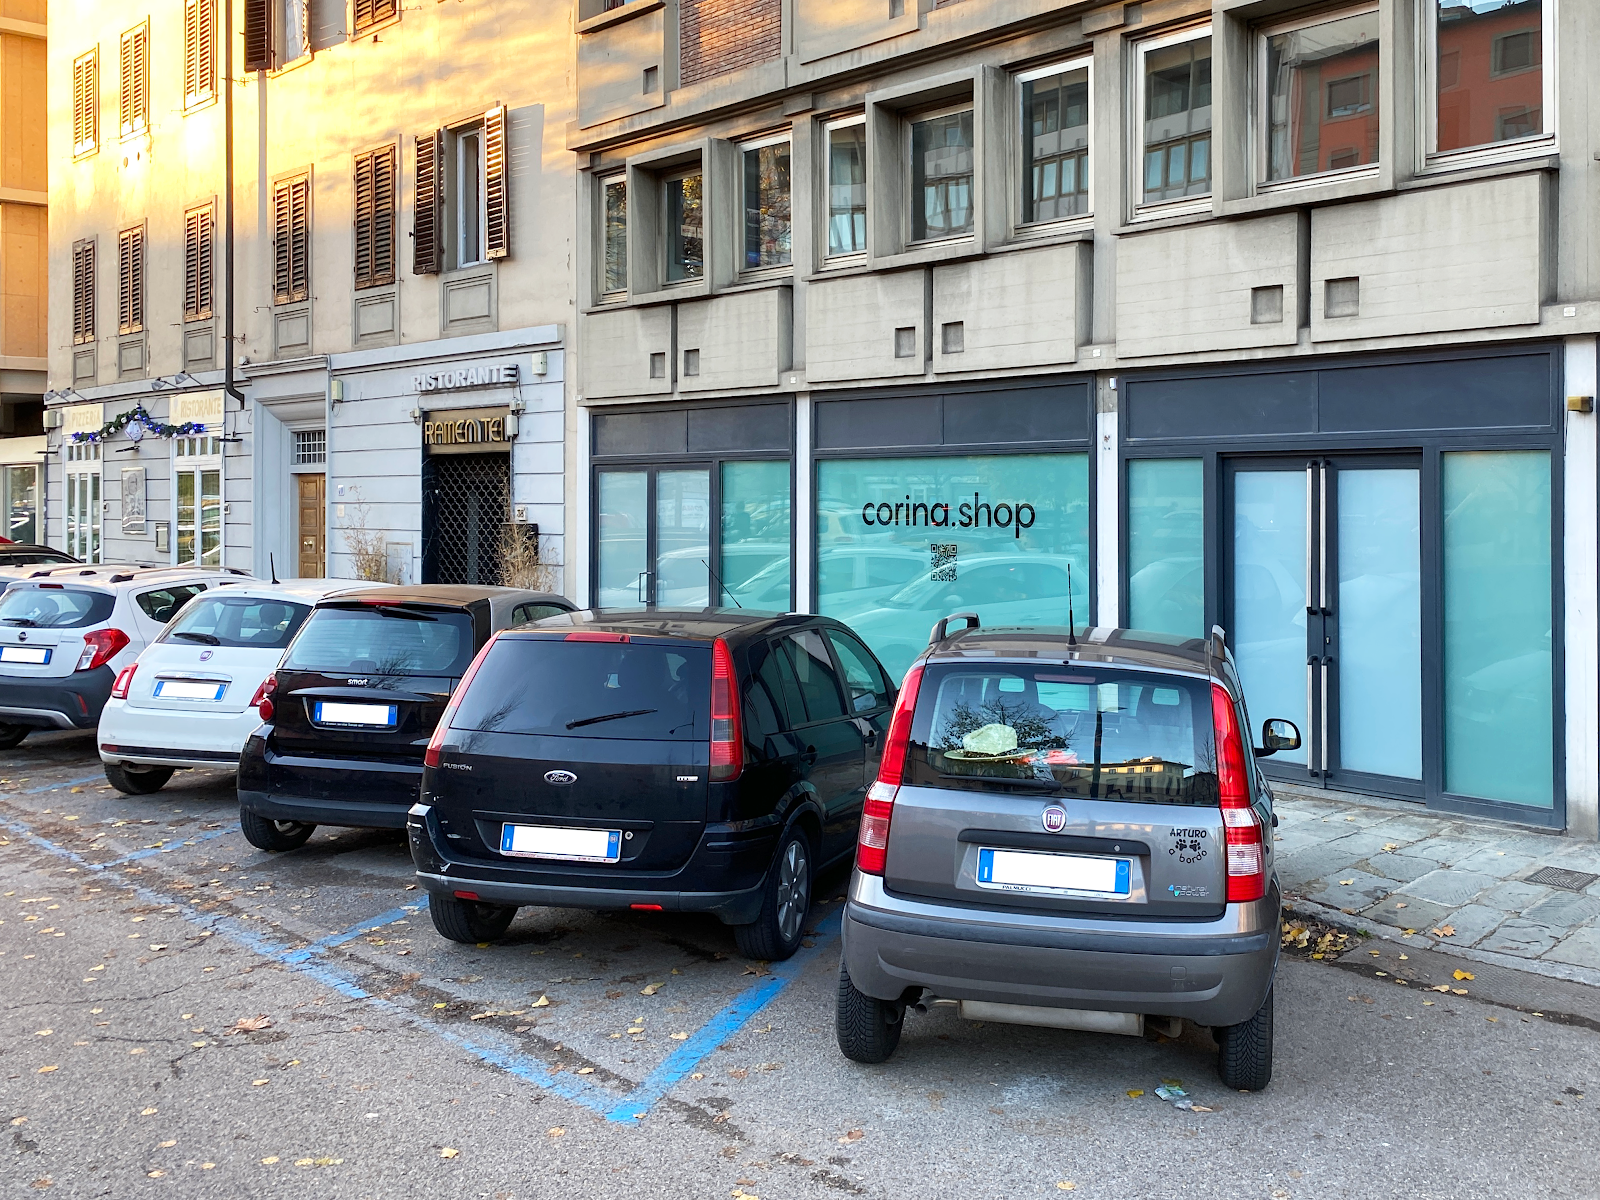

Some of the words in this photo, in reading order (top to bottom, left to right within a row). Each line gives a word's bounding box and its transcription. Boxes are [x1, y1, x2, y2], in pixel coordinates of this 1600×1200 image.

[411, 364, 518, 392] RISTORANTE
[180, 396, 222, 418] RISTORANTE
[424, 419, 481, 444] RAMEN
[862, 491, 1036, 539] corina.shop
[347, 678, 368, 686] smart
[443, 762, 473, 771] FUSION
[549, 772, 569, 782] Ford
[1047, 813, 1062, 827] FIAT
[1169, 828, 1207, 838] ARTURO
[1178, 850, 1208, 864] bordo
